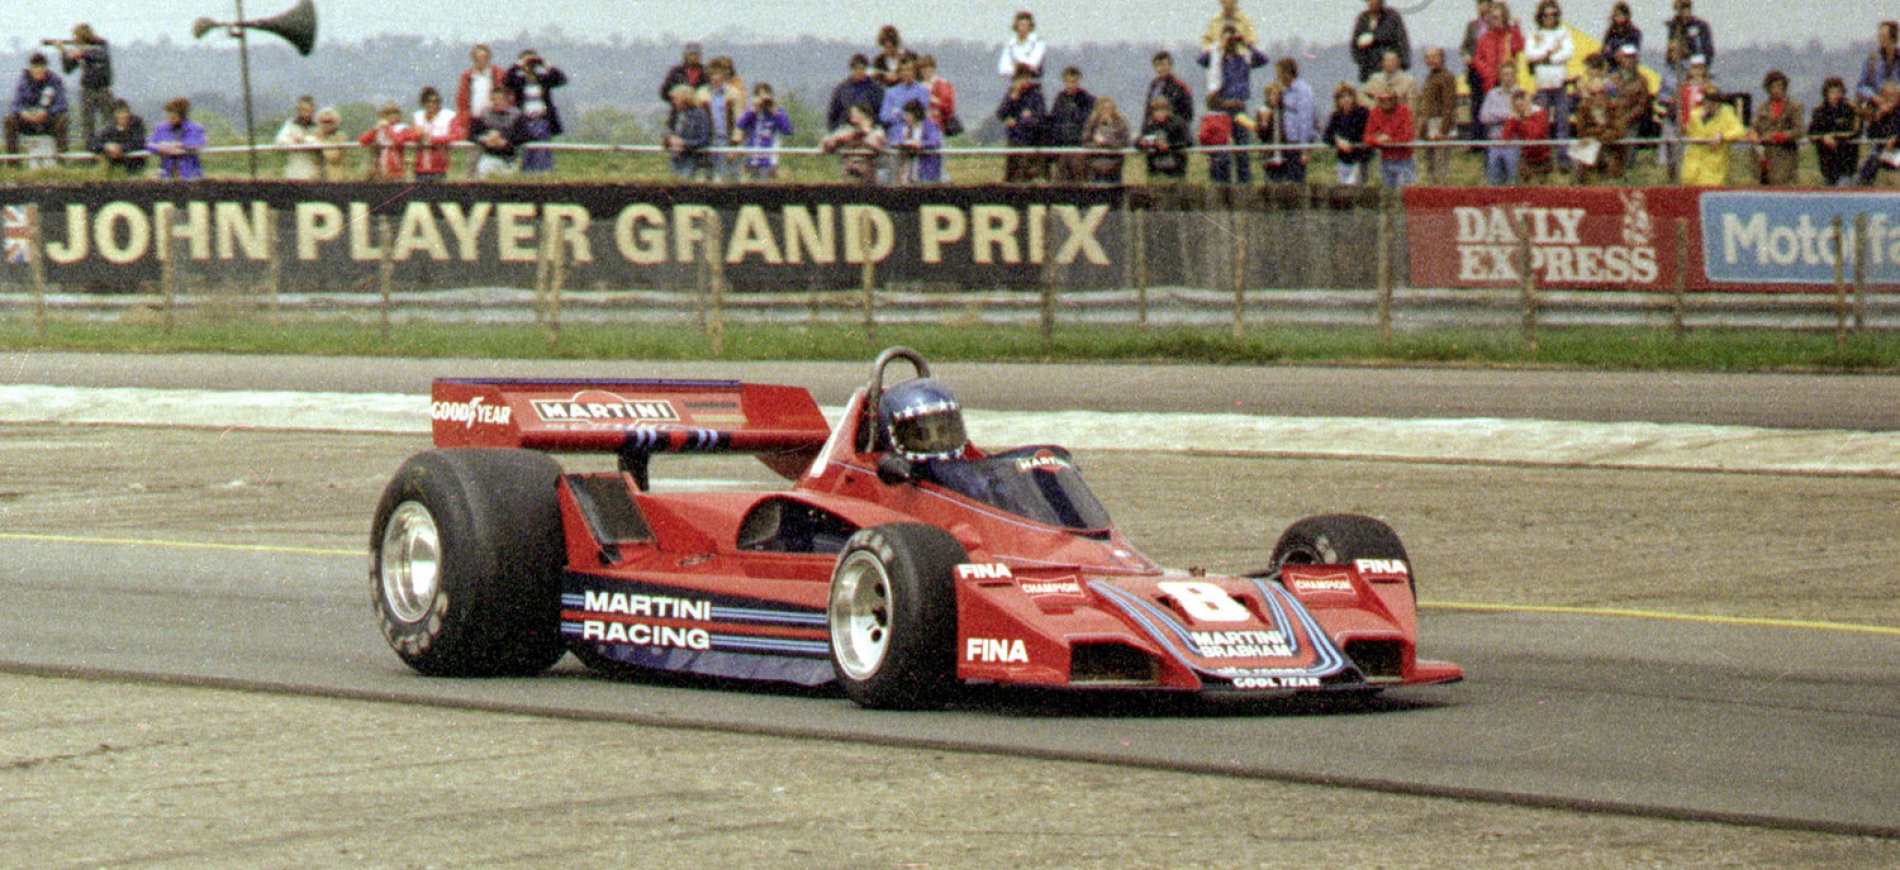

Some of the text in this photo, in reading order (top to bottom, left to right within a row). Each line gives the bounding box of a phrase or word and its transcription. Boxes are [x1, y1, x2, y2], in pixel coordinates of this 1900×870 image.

[46, 201, 1110, 265] JOHN PLAYER GRAND PRIX
[540, 402, 670, 420] MARTINI
[958, 562, 1012, 579] FINA
[1354, 559, 1407, 575] FINA
[1021, 582, 1081, 594] CHAMPION
[584, 590, 711, 621] MARTINI
[1157, 581, 1251, 622] 8
[583, 620, 711, 650] RACING
[1191, 629, 1285, 646] MARTINI
[966, 637, 1029, 663] FINA
[1199, 644, 1293, 658] BRABHAM
